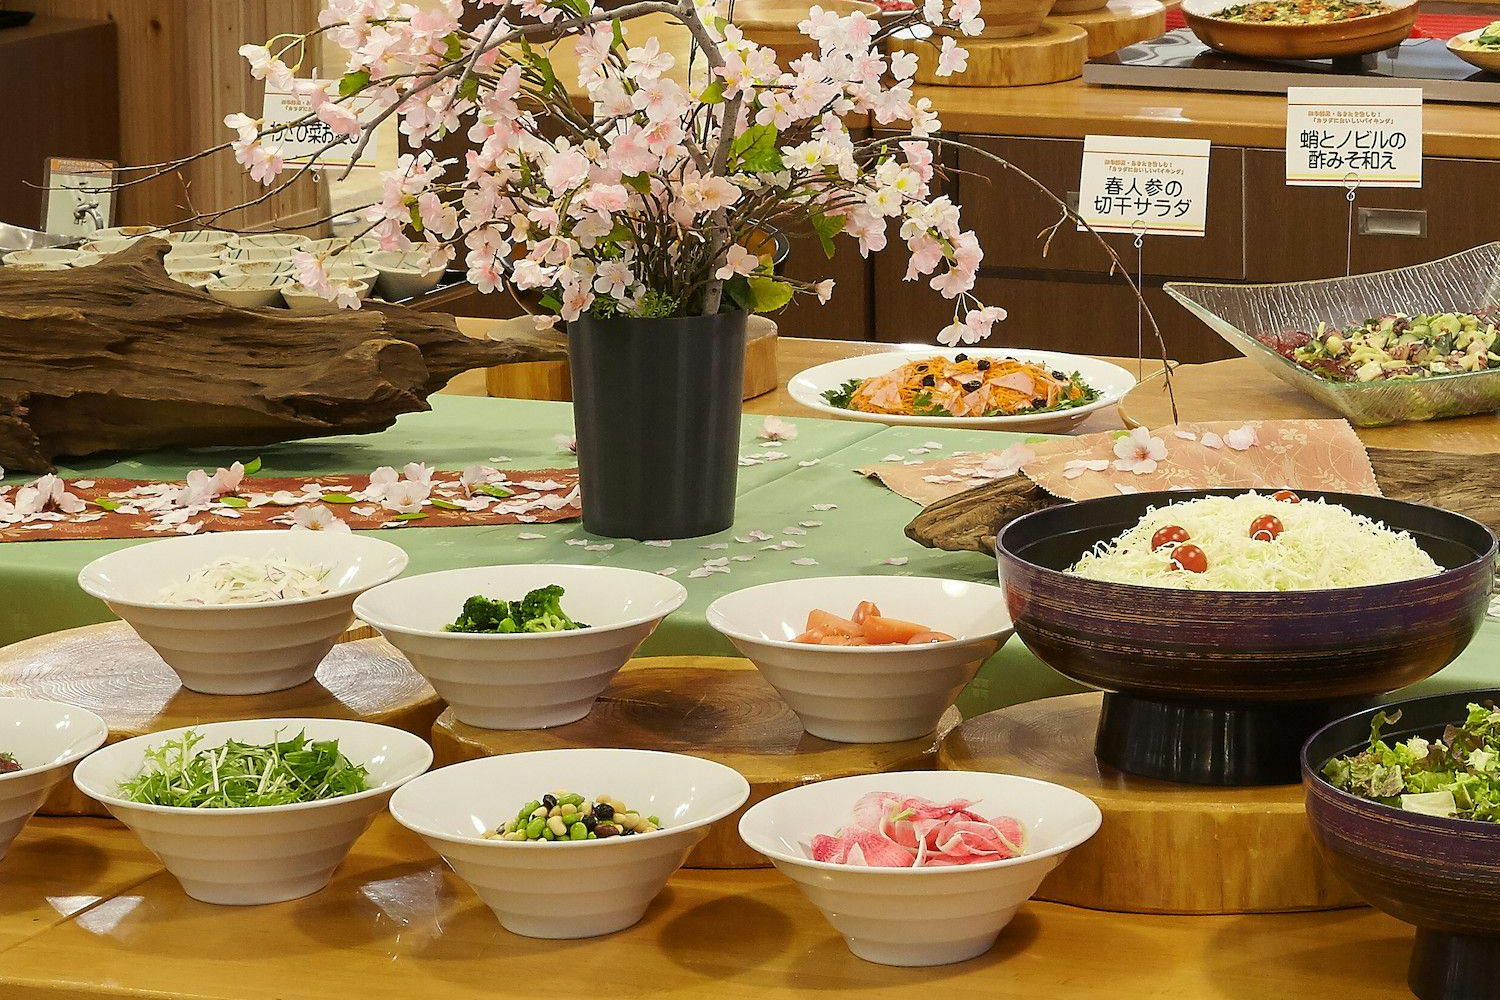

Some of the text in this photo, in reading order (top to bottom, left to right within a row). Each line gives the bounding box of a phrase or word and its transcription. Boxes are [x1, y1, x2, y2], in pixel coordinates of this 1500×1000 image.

[1299, 129, 1407, 150] 蛸とノビルの
[1308, 150, 1397, 170] 酢みそ和え
[1104, 176, 1183, 198] 春人参の
[1093, 195, 1193, 218] 切干サラダ
